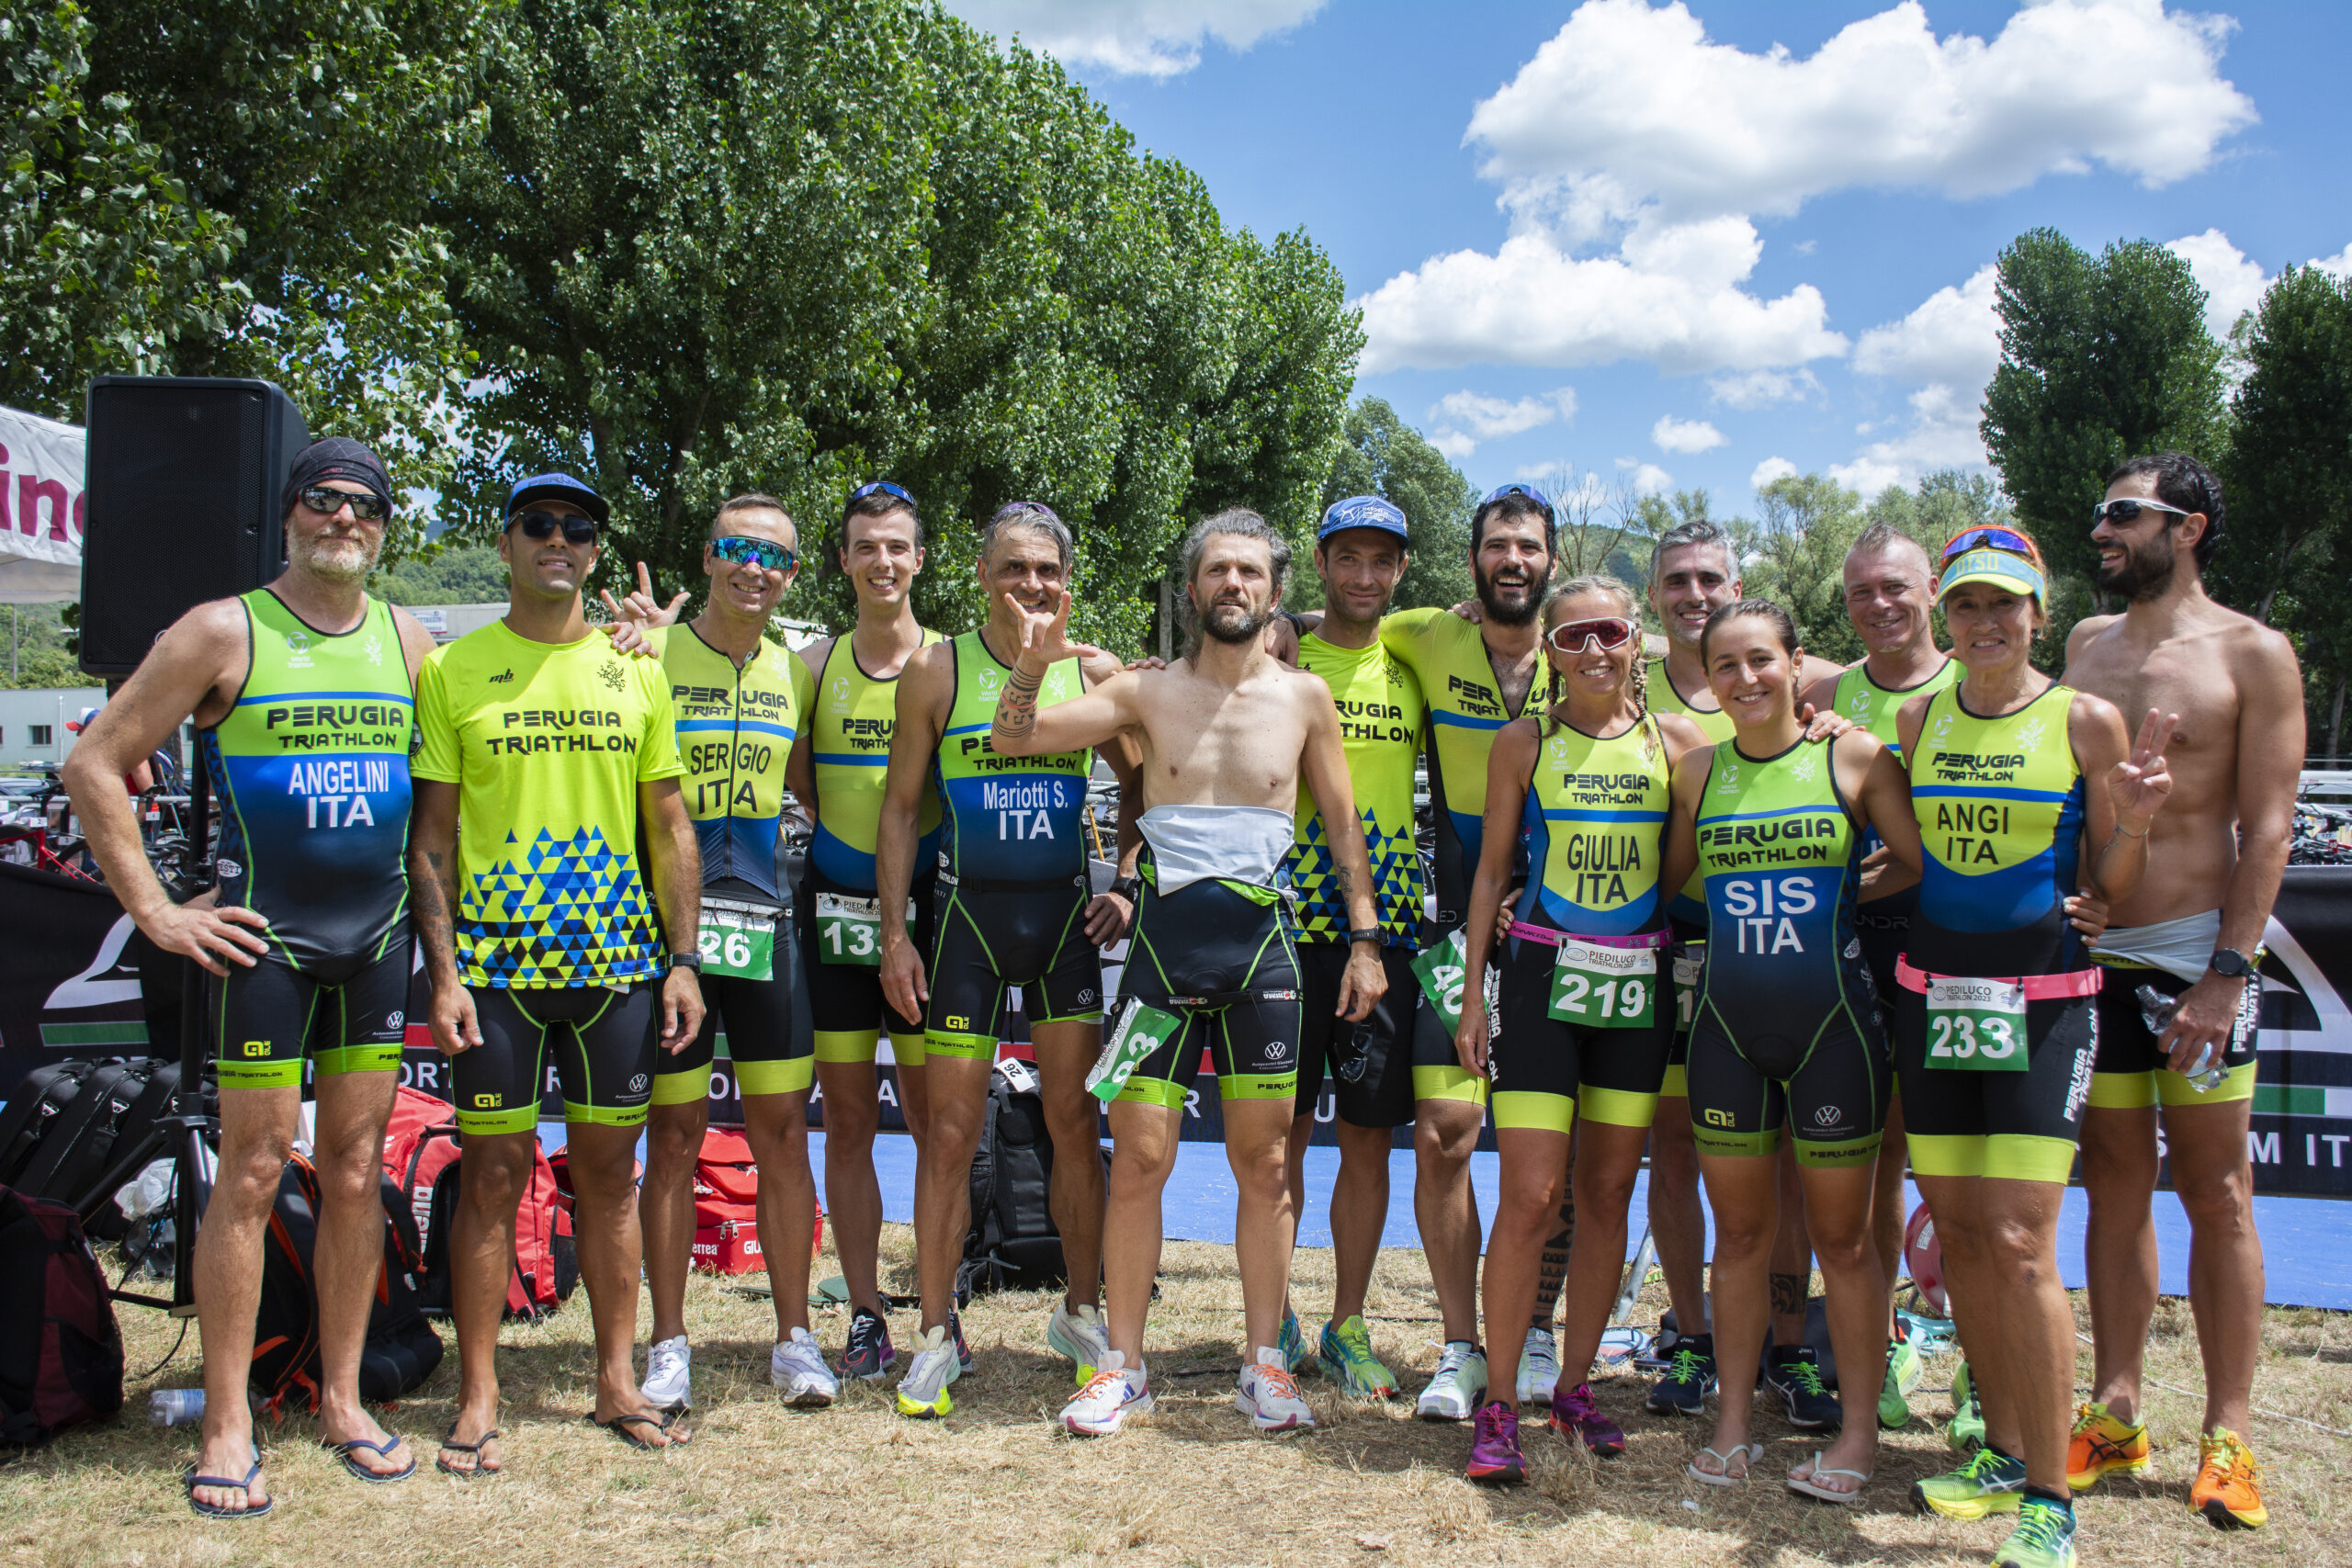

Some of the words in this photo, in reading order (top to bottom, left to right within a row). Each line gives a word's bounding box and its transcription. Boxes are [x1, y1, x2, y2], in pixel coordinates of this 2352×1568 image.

[672, 684, 789, 711] PERUGIA
[1335, 699, 1402, 720] RUGIA
[266, 705, 404, 730] PERUGIA
[503, 710, 622, 730] PERUGIA
[682, 705, 779, 722] TRIATHLON
[842, 718, 897, 738] PERU
[1342, 725, 1414, 747] THLON
[278, 733, 397, 750] TRIATHLON
[487, 734, 638, 756] TRIATHLON
[850, 738, 891, 750] TRIATH
[690, 742, 772, 775] SERGIO
[973, 756, 1077, 772] TRIATHLON
[1931, 751, 2025, 769] PERUGIA
[288, 761, 390, 795] ANGELINI
[1563, 773, 1650, 793] PERUGIA
[1936, 769, 2014, 783] TRIATHLON
[698, 777, 757, 814] ITA
[983, 782, 1048, 809] Mariotti
[1053, 781, 1069, 808] S.
[1572, 792, 1643, 806] TRIATHLON
[309, 795, 375, 829] ITA
[999, 809, 1055, 840] ITA
[1937, 803, 2009, 835] ANGI
[1700, 818, 1836, 851] PERUGIA
[1566, 833, 1641, 872] GIULIA
[1707, 843, 1826, 868] TRIATHLON
[1946, 837, 1998, 865] ITA
[1576, 873, 1629, 904] ITA
[1724, 876, 1816, 917] SIS
[824, 921, 882, 955] 13
[1737, 918, 1804, 954] ITA
[1589, 950, 1636, 964] PIEDILUCO
[1589, 958, 1623, 969] TRIATHLON
[1489, 968, 1501, 1039] PERUGIA
[1555, 973, 1645, 1018] 219
[1946, 986, 1992, 996] PIEDILUCO
[1973, 994, 1991, 1002] 2023
[1930, 1015, 2016, 1059] 233
[2077, 1008, 2099, 1105] TRIATHLON
[2064, 1047, 2087, 1122] PERUGIA
[1810, 1146, 1866, 1158] PERUGIA
